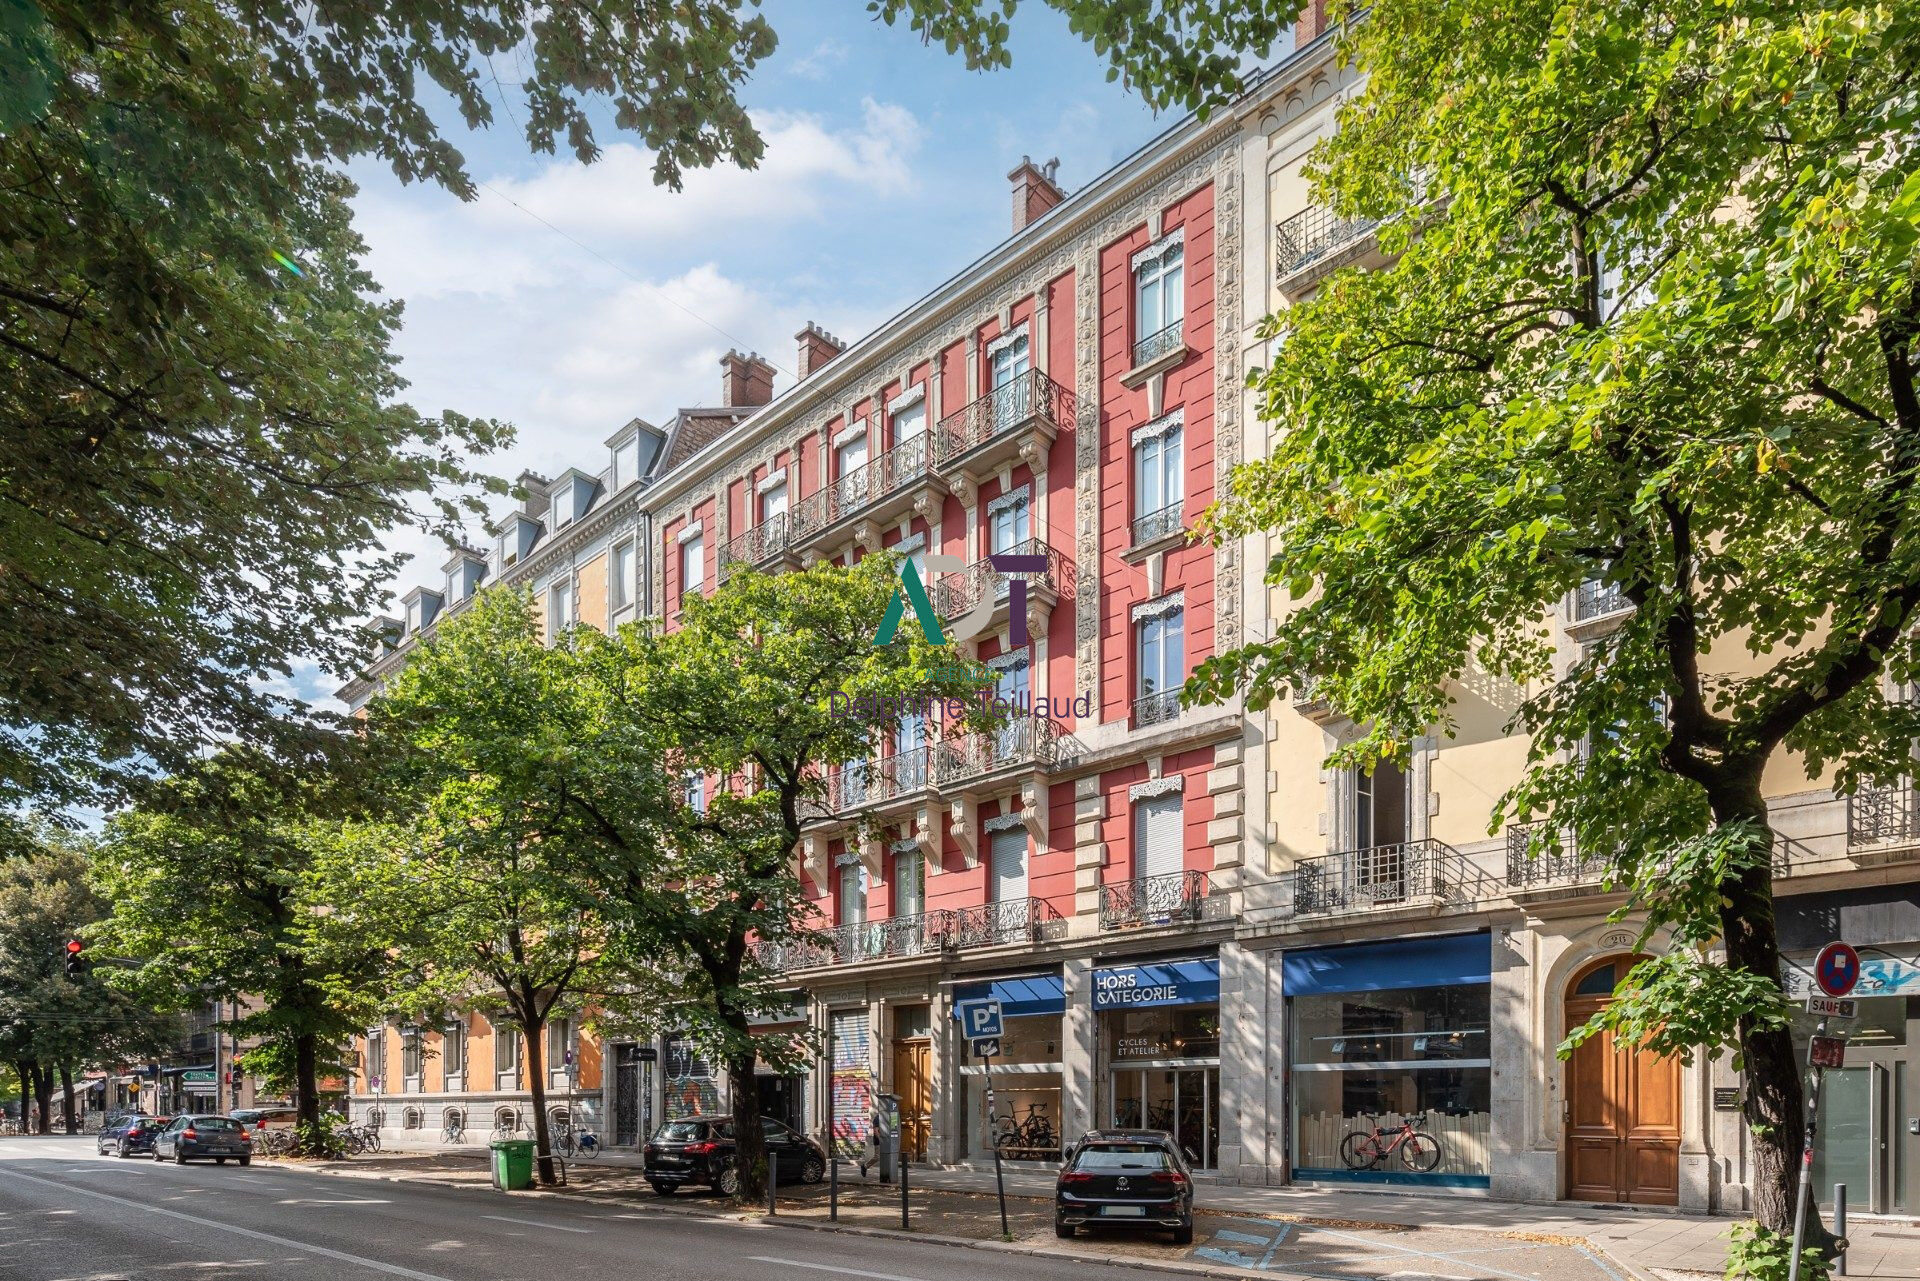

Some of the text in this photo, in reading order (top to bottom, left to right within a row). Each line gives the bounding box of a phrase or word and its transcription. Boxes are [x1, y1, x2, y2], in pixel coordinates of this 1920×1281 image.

[1096, 973, 1136, 990] HORS
[1097, 985, 1178, 1004] CATEGORIE
[1812, 1000, 1839, 1013] SAUF
[973, 1008, 991, 1032] P
[1118, 1038, 1148, 1047] CYCLES
[1118, 1047, 1160, 1056] ET ATELIER
